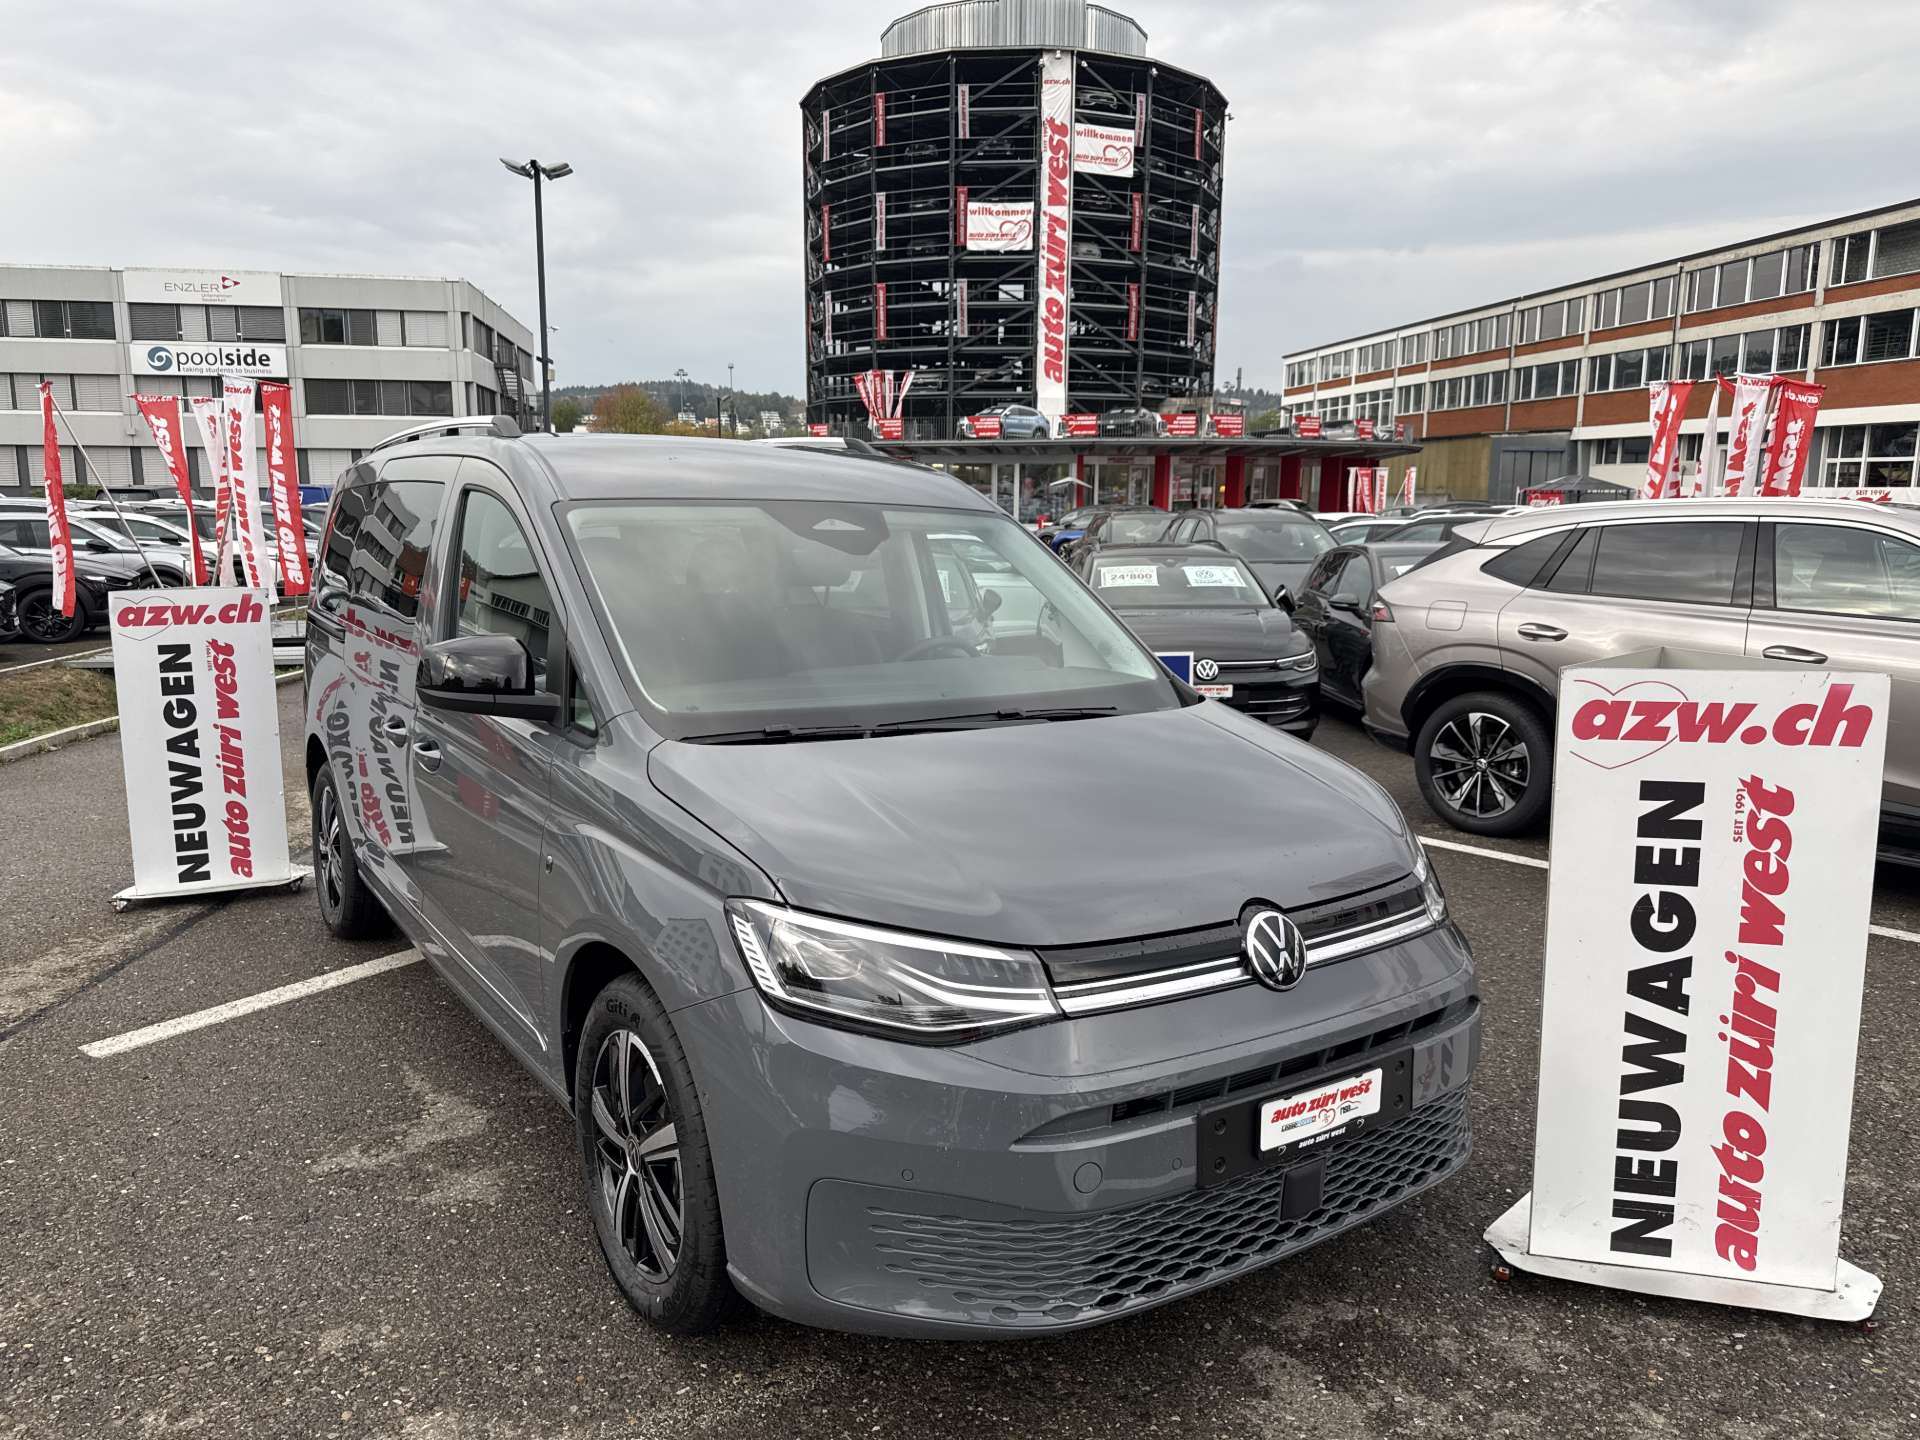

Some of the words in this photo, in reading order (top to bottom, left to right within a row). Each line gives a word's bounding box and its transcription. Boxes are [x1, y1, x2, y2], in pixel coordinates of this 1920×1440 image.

[1045, 116, 1069, 206] west
[1075, 128, 1133, 143] willkommen
[968, 206, 1032, 217] willkommen
[1041, 210, 1068, 296] züri
[164, 282, 220, 292] ENZLER
[176, 347, 271, 371] poolside
[183, 366, 204, 374] taking
[206, 366, 233, 374] students
[1041, 297, 1065, 383] auto
[229, 407, 243, 471] west
[279, 526, 304, 585] auto
[117, 594, 263, 627] azw.ch
[206, 638, 240, 719] west
[1572, 683, 1874, 748] azw.ch
[157, 643, 211, 884] NEUWAGEN
[212, 723, 247, 800] züri
[1733, 818, 1743, 843] SEIT
[1735, 788, 1746, 815] 1991
[221, 800, 253, 879] auto
[1737, 775, 1795, 947] west
[1610, 779, 1706, 1259] NEUWAGEN
[1717, 950, 1781, 1113] züri
[1270, 1101, 1307, 1124] auto
[1307, 1087, 1340, 1113] züri
[1340, 1078, 1373, 1101] west
[1710, 1110, 1767, 1273] auto
